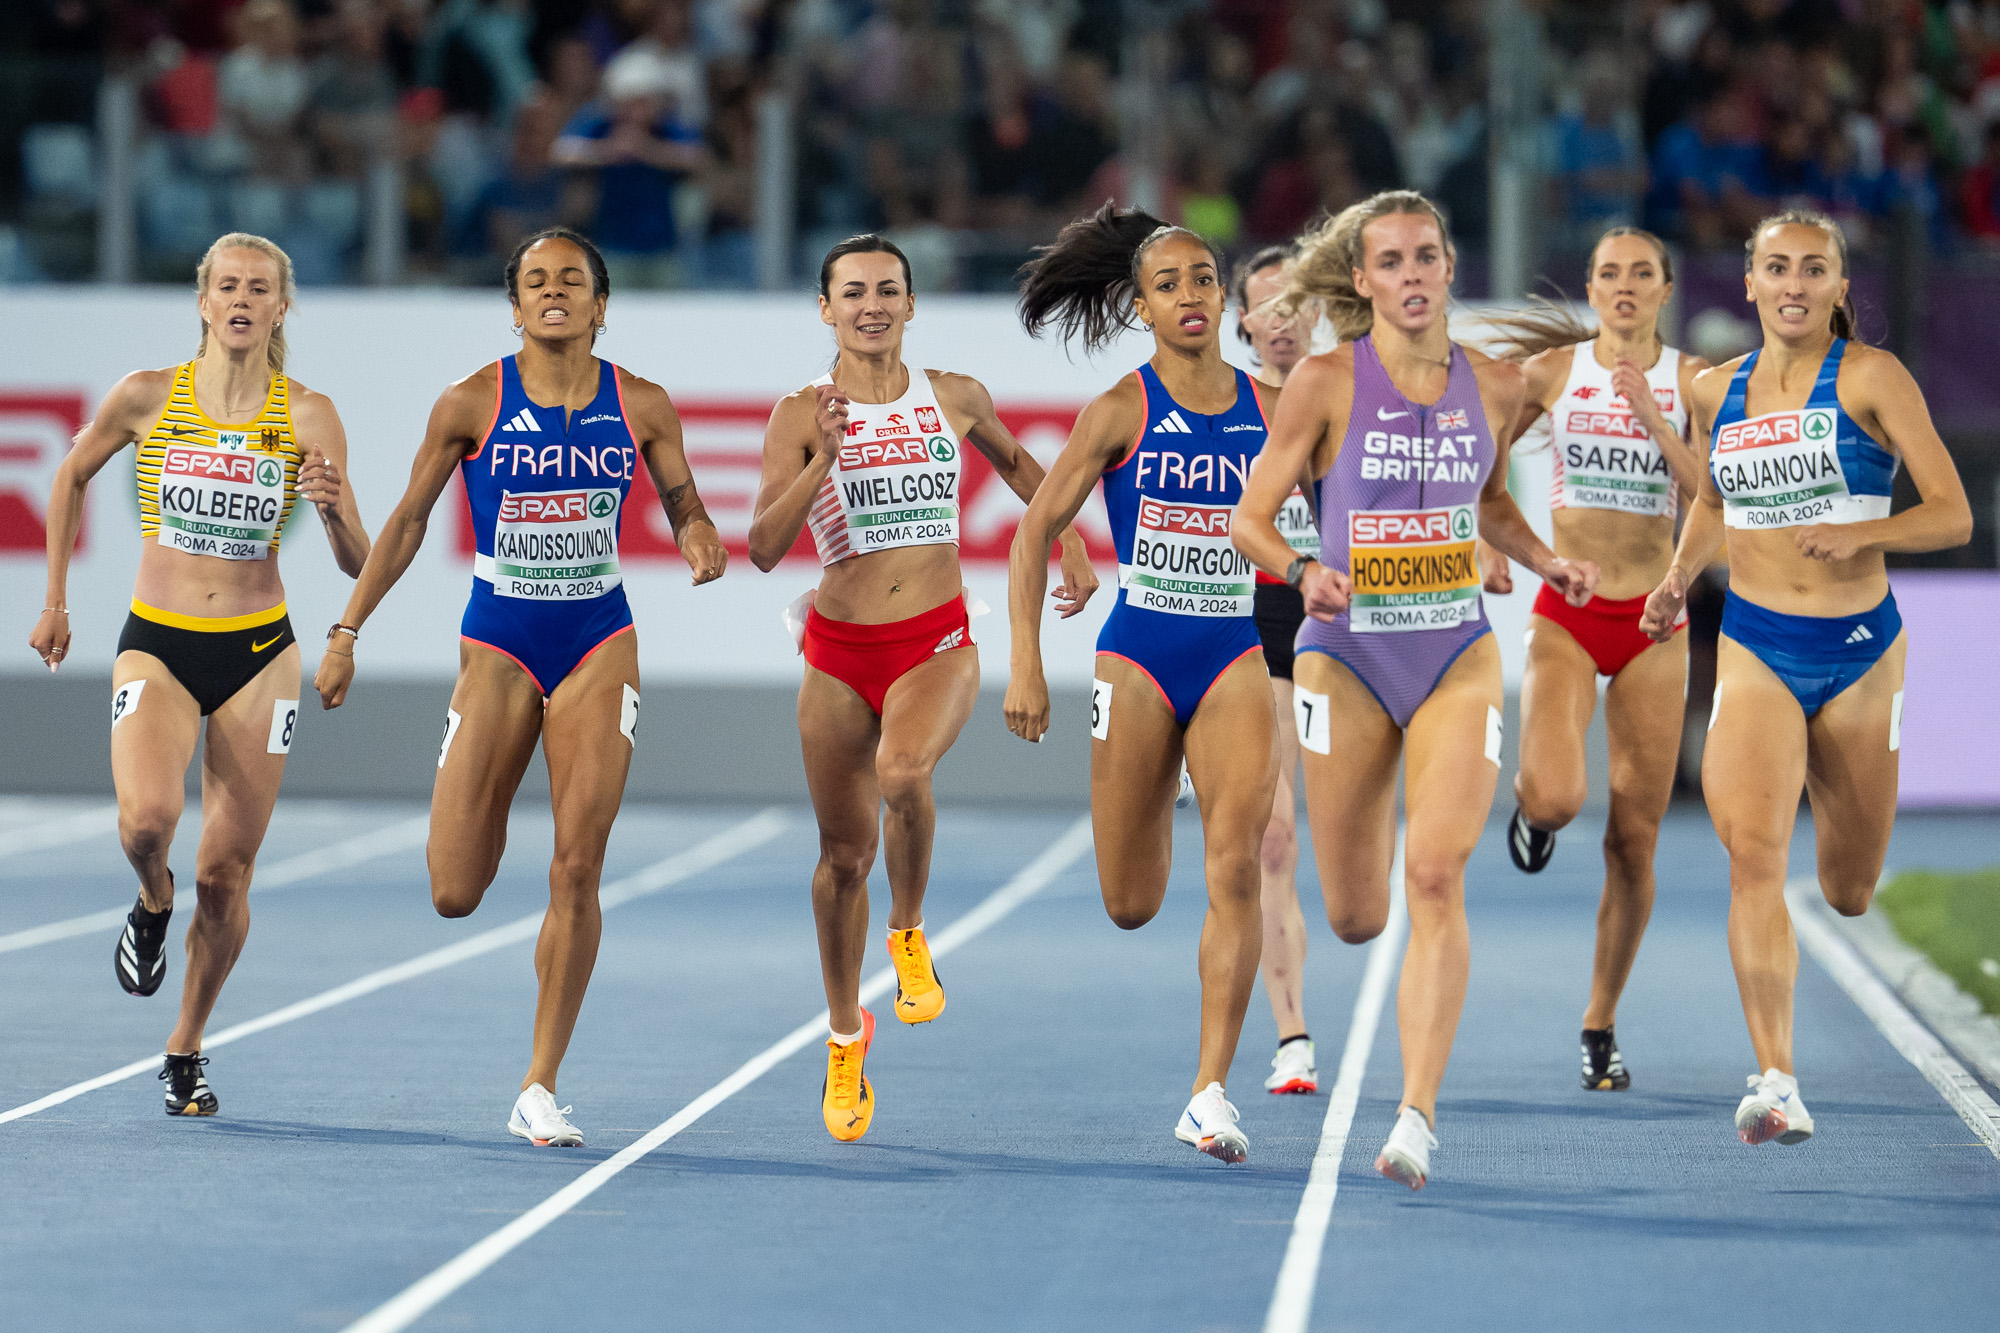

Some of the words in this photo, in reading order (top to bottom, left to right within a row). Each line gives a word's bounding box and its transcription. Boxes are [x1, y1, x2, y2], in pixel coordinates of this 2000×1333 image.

[877, 426, 909, 437] ORLEN
[1364, 430, 1478, 459] GREAT
[1720, 418, 1798, 451] SPAR
[167, 452, 253, 481] SPAR
[490, 443, 634, 481] FRANCE
[839, 440, 928, 468] SPAR
[1567, 444, 1668, 476] SARNA
[1135, 451, 1262, 492] FRAN
[1360, 456, 1480, 483] BRITAIN
[1719, 444, 1838, 493] GAJANOVÁ
[162, 484, 278, 523] KOLBERG
[842, 471, 956, 508] WIELGOSZ
[1574, 489, 1619, 505] ROMA
[1621, 494, 1657, 508] 2024
[500, 496, 586, 520] SPAR
[876, 511, 902, 524] RUN
[902, 508, 942, 521] CLEAN
[1142, 503, 1229, 533] SPAR
[1746, 510, 1791, 526] ROMA
[1792, 498, 1833, 521] 2024
[186, 521, 211, 535] RUN
[211, 524, 249, 539] CLEAN
[865, 525, 914, 545] ROMA
[915, 523, 953, 540] 2024
[1353, 514, 1449, 542] SPAR
[173, 532, 218, 554] ROMA
[221, 541, 256, 557] 2024
[497, 526, 614, 562] KANDISSOUNON
[1136, 538, 1251, 577] BOURGOIN
[525, 568, 552, 579] RUN
[553, 566, 592, 579] CLEAN
[1354, 550, 1473, 587] HODGKINSON
[511, 580, 563, 597] ROMA
[566, 579, 605, 597] 2024
[1159, 579, 1187, 592] RUN
[1188, 583, 1229, 595] CLEAN
[1385, 594, 1415, 606] RUN
[1143, 591, 1196, 612] ROMA
[1199, 598, 1238, 613] 2024
[1370, 610, 1427, 627] ROMA
[1430, 605, 1467, 624] 2024
[113, 689, 129, 722] 8
[281, 709, 297, 748] 8
[1091, 688, 1101, 729] 6
[1301, 700, 1313, 740] 7
